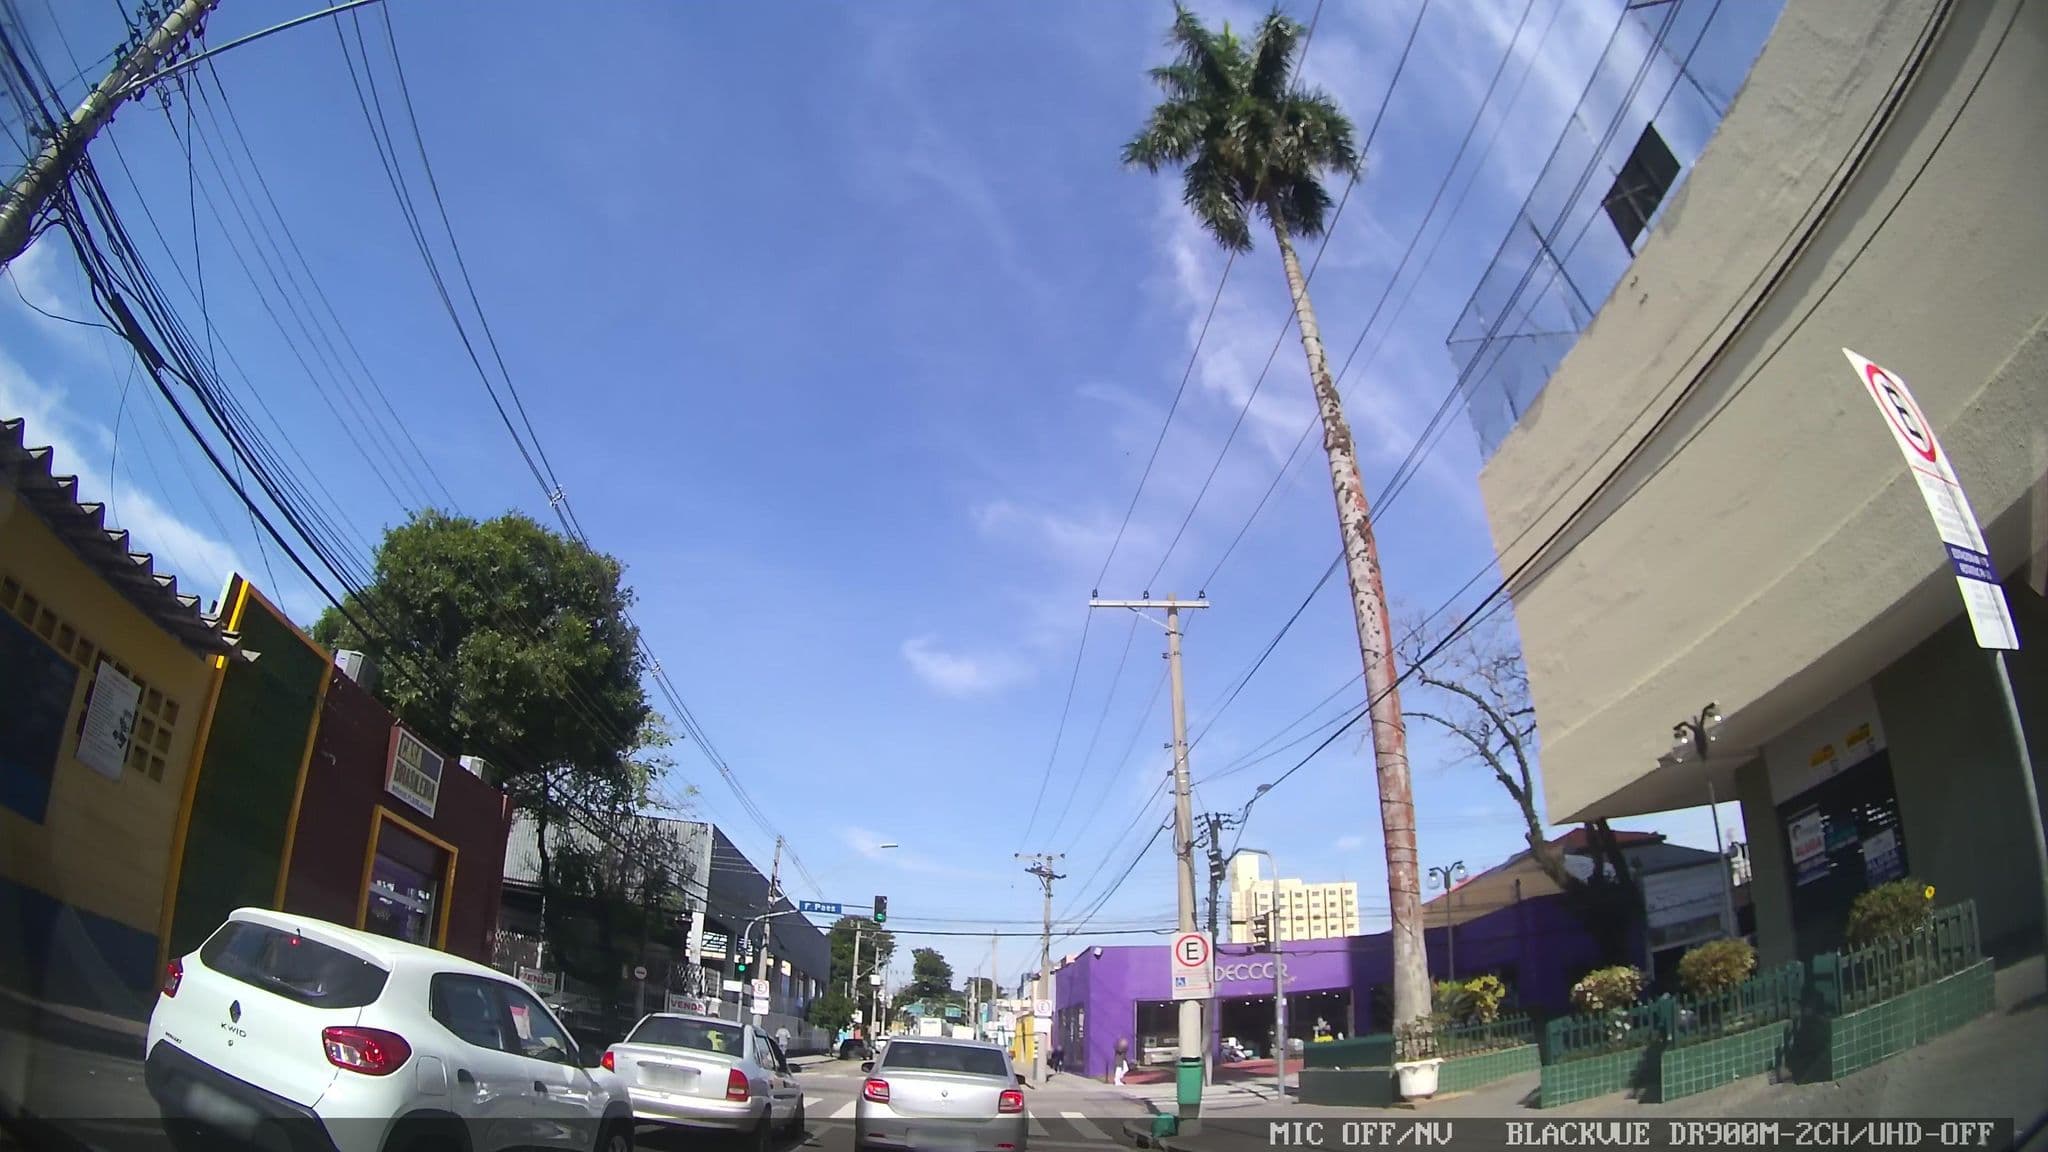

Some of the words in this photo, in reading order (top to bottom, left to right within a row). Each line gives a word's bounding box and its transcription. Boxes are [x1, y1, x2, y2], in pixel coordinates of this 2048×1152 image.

[1882, 381, 1925, 443] E
[1186, 942, 1199, 961] E
[221, 1023, 247, 1038] KWID
